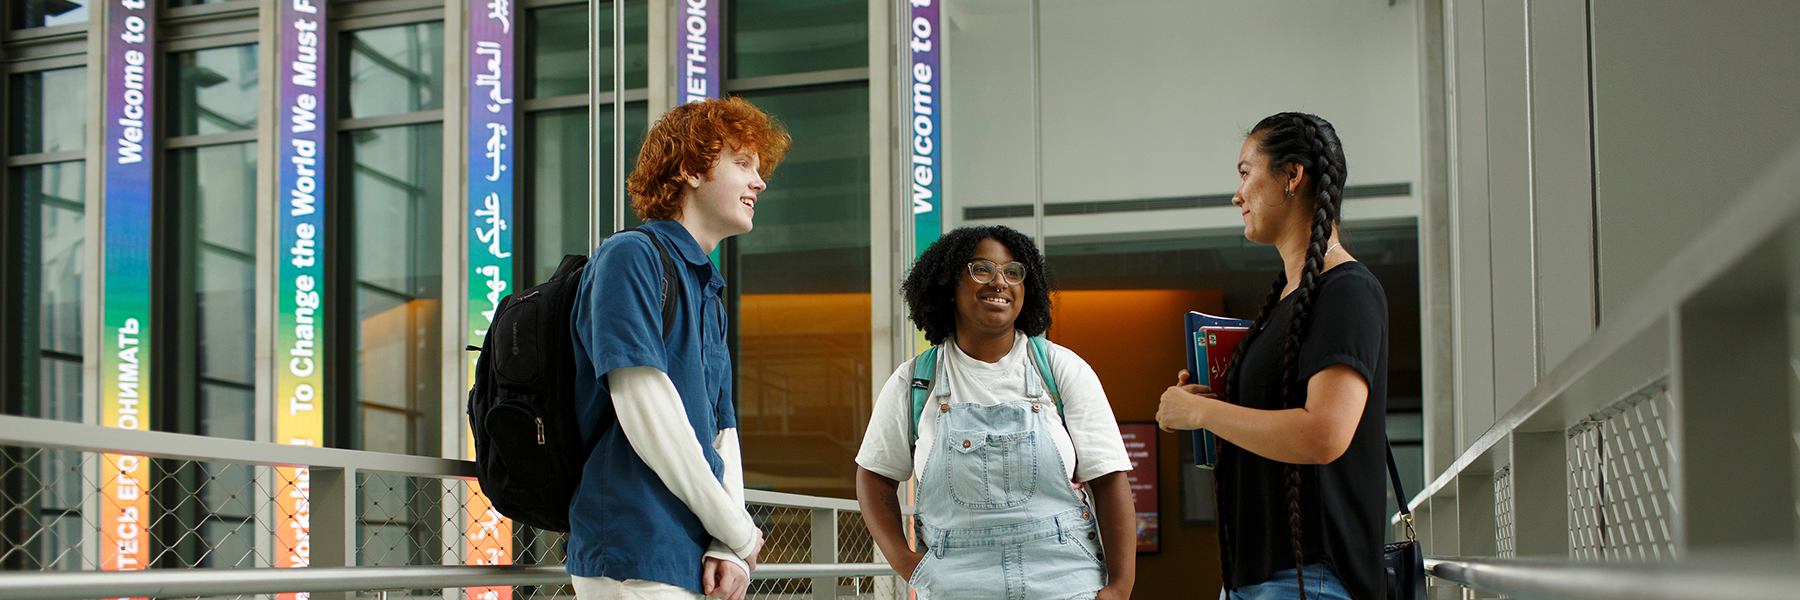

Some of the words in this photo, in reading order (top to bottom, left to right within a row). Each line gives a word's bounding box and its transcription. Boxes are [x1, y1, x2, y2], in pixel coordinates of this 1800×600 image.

[122, 16, 143, 43] to
[293, 18, 316, 87] Must
[910, 17, 932, 52] to
[119, 51, 143, 164] Welcome
[292, 94, 315, 132] We
[911, 63, 932, 213] Welcome
[292, 138, 315, 216] World
[485, 123, 507, 180] يجب
[291, 223, 314, 268] the
[475, 193, 510, 257] عليكم
[290, 276, 318, 377] Change
[118, 319, 139, 430] ОНИМАТЬ
[290, 385, 314, 416] To
[118, 456, 138, 500] ЕГО
[118, 507, 138, 571] ТЕСЬ
